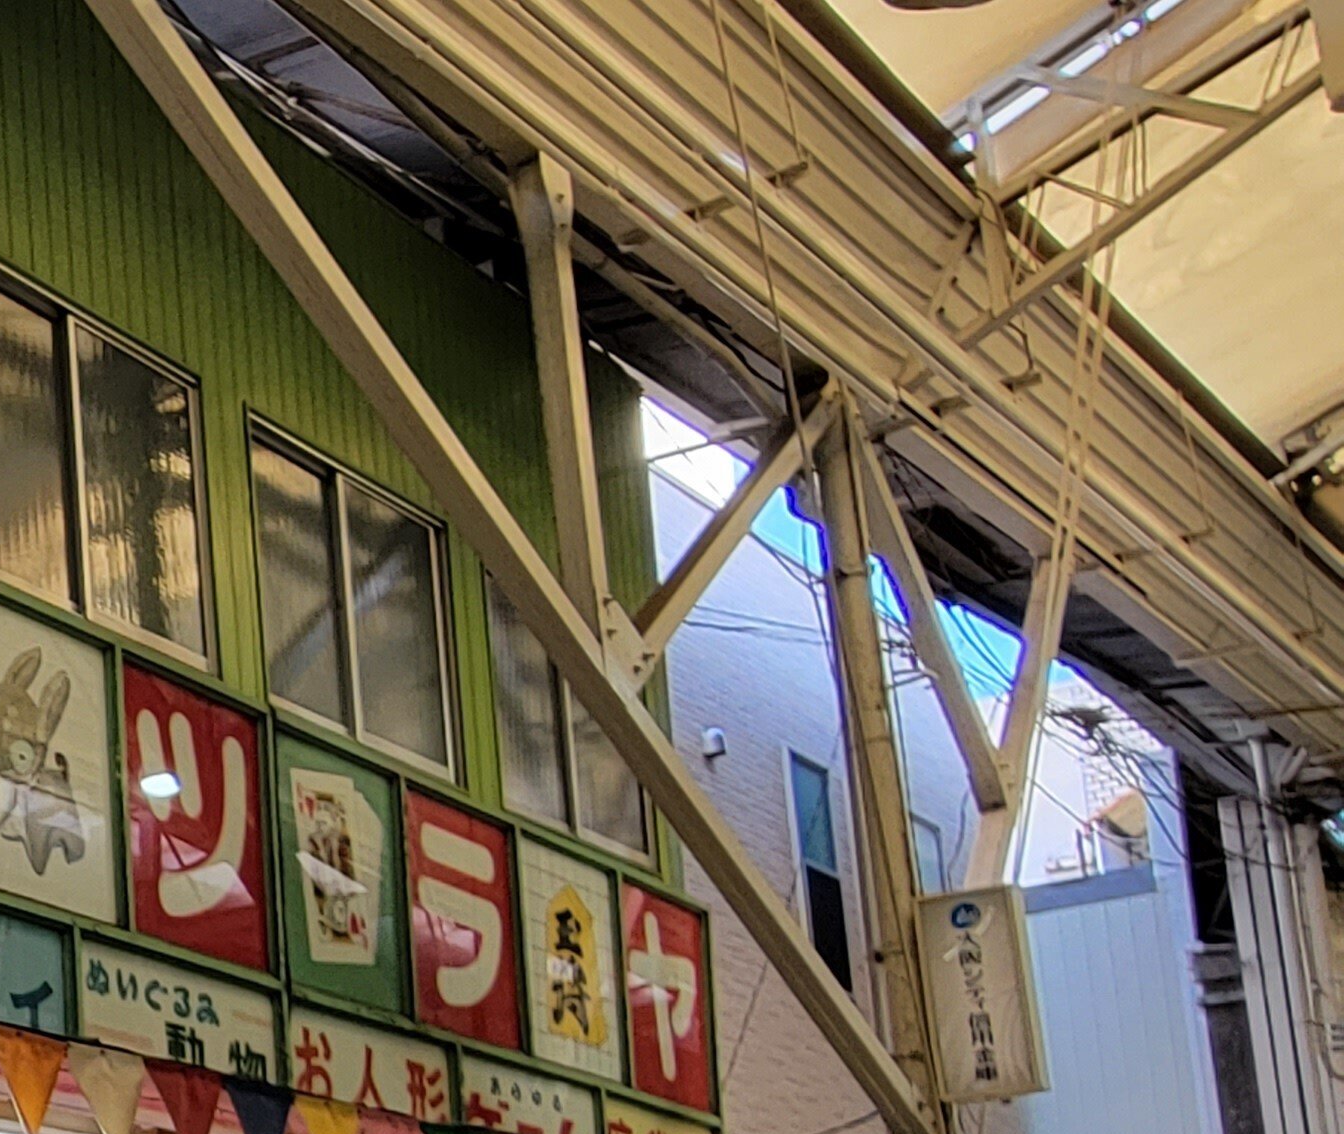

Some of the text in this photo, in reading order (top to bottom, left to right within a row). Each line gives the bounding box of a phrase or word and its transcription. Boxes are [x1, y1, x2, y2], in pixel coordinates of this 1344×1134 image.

[86, 958, 220, 1028] ぬいぐるみ
[164, 1020, 268, 1080] 動物
[293, 1026, 447, 1123] お人形
